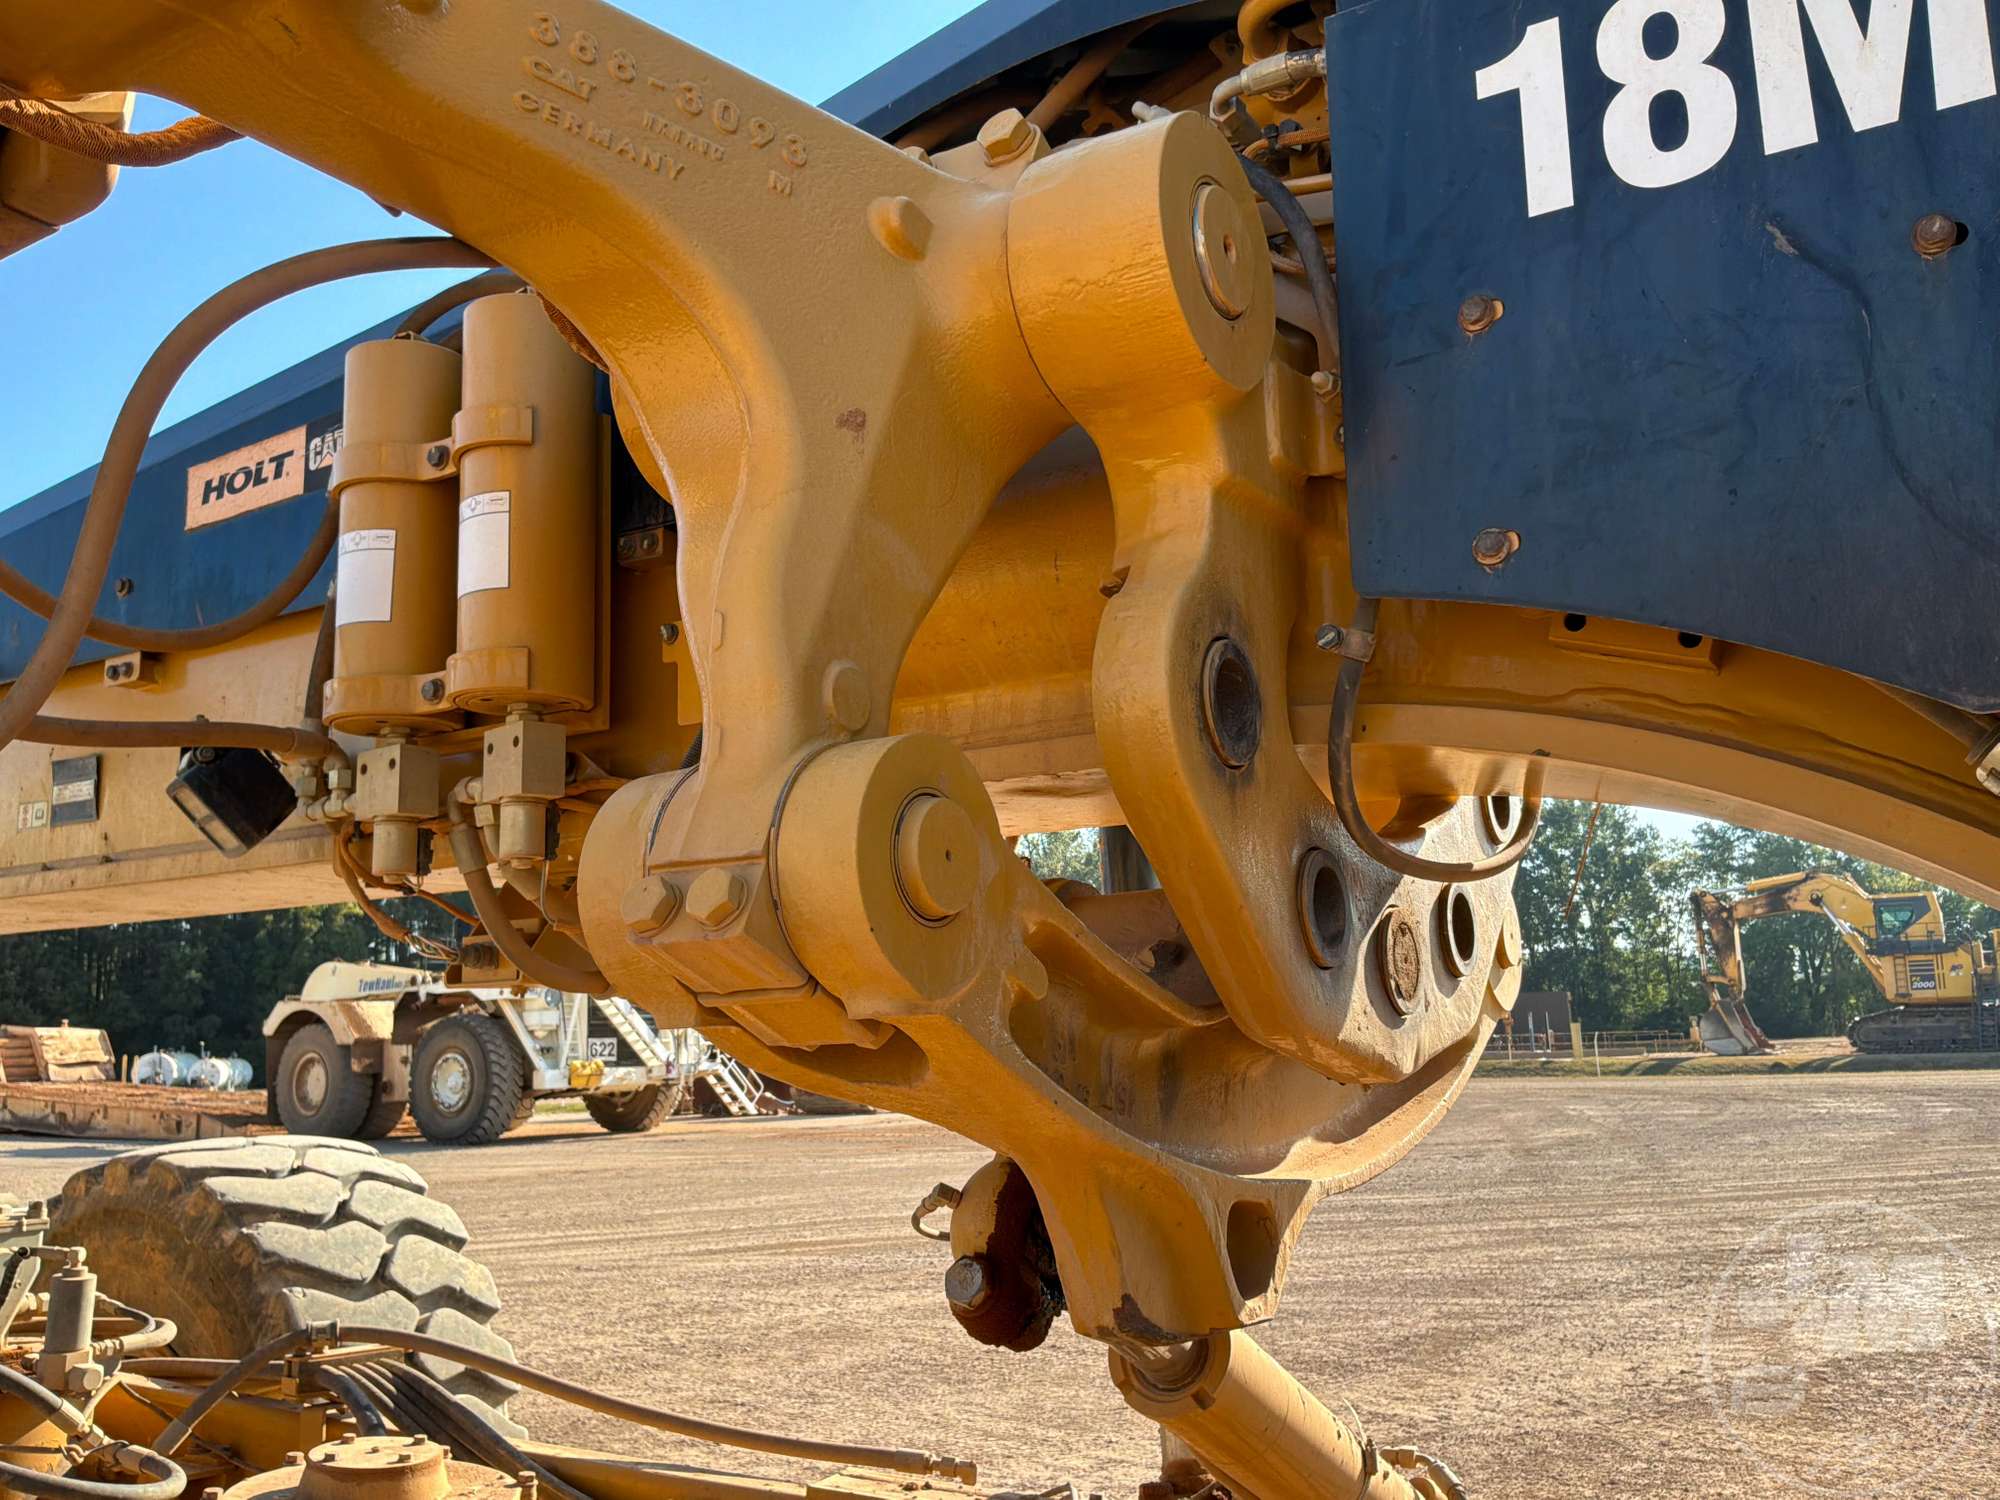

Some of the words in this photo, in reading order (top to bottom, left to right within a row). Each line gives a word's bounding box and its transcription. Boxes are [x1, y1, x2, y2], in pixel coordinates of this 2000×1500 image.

[522, 55, 599, 103] CAT
[512, 91, 686, 181] GERMANY
[1475, 0, 1997, 218] 18M
[201, 449, 294, 505] HOLT
[590, 1041, 616, 1057] 622
